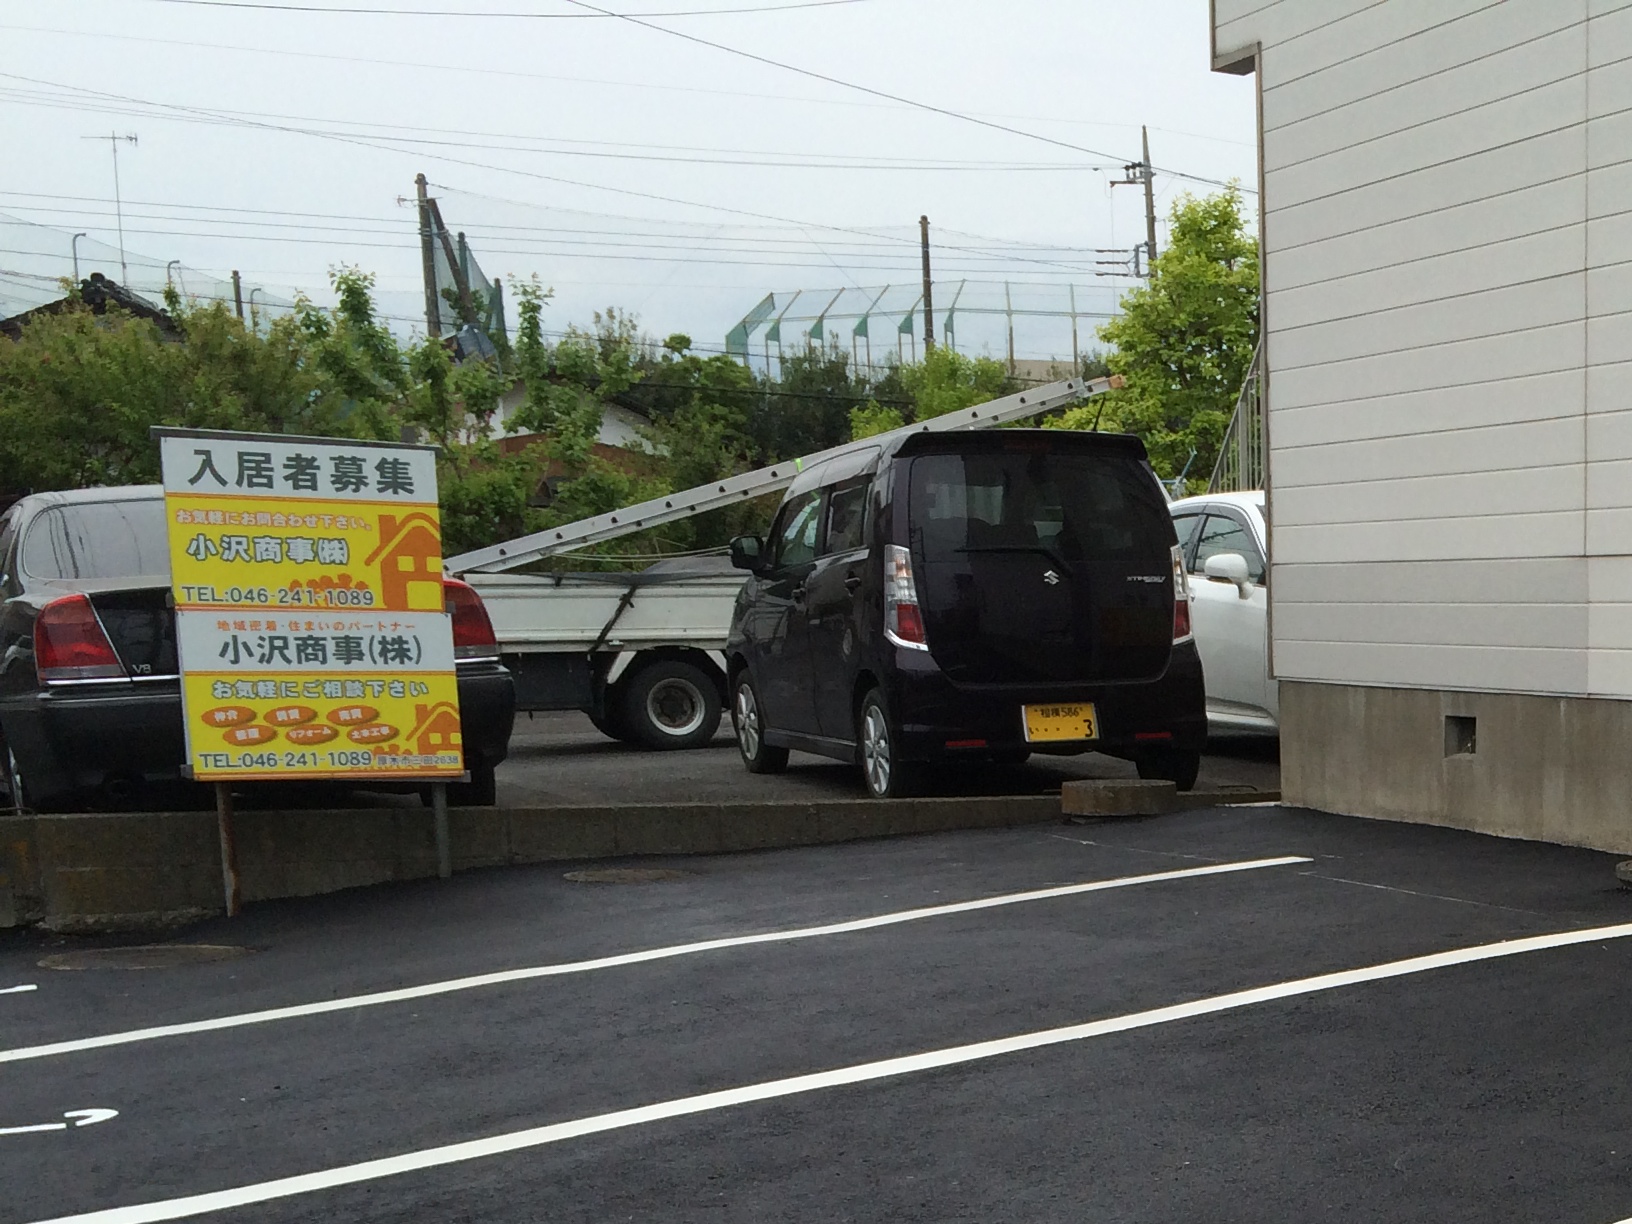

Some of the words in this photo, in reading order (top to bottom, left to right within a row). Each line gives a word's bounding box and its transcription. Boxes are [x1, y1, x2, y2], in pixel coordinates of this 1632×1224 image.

[188, 449, 415, 495] 入居者募集
[176, 509, 372, 531] お気軽にお問合わせ下さい。
[181, 586, 374, 606] TEL:046-241-1089
[212, 679, 429, 698] お気軽にご相談下さい
[198, 751, 372, 768] TEL:046-241-1089
